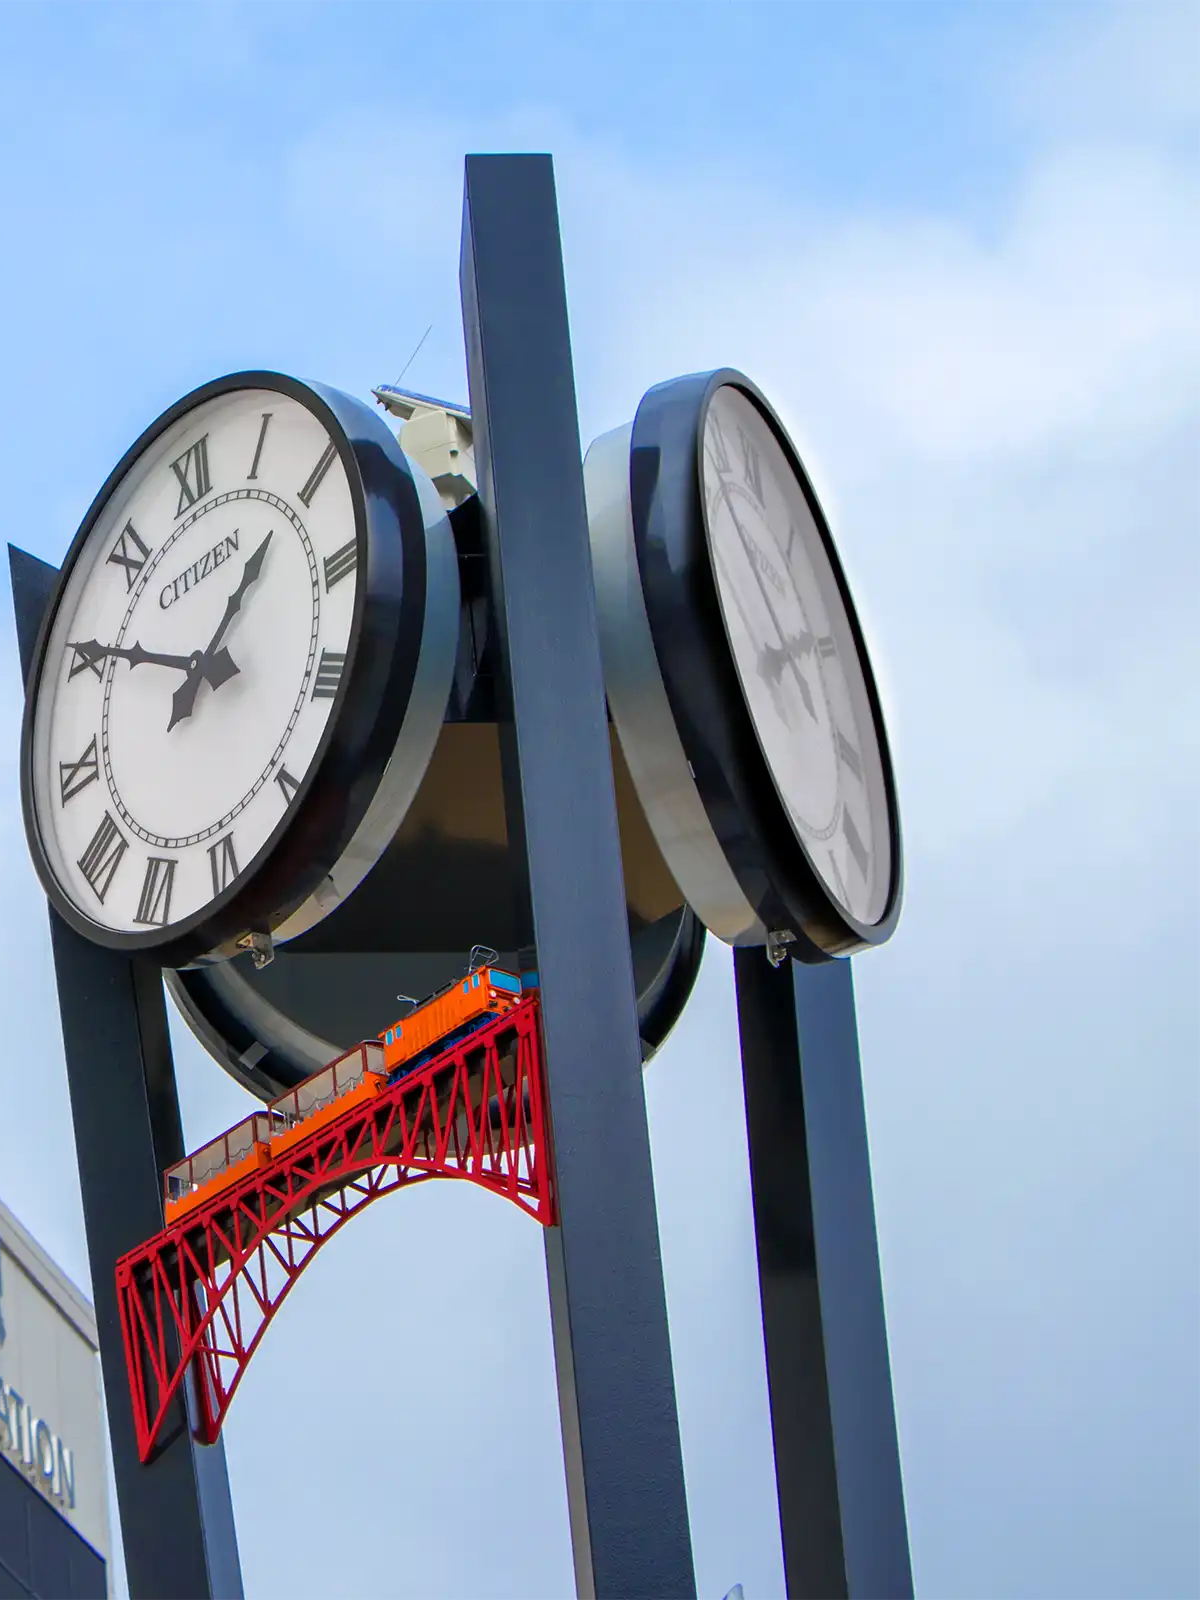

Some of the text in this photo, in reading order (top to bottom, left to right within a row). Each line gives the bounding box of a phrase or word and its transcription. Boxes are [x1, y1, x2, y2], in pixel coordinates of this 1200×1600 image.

[169, 432, 213, 520] XII
[246, 413, 273, 480] I
[297, 436, 338, 509] II
[105, 518, 153, 594] XI
[159, 528, 240, 610] CITIZEN
[323, 537, 357, 594] III
[59, 733, 99, 808] IX
[77, 809, 129, 905] VIII
[133, 856, 179, 926] VII
